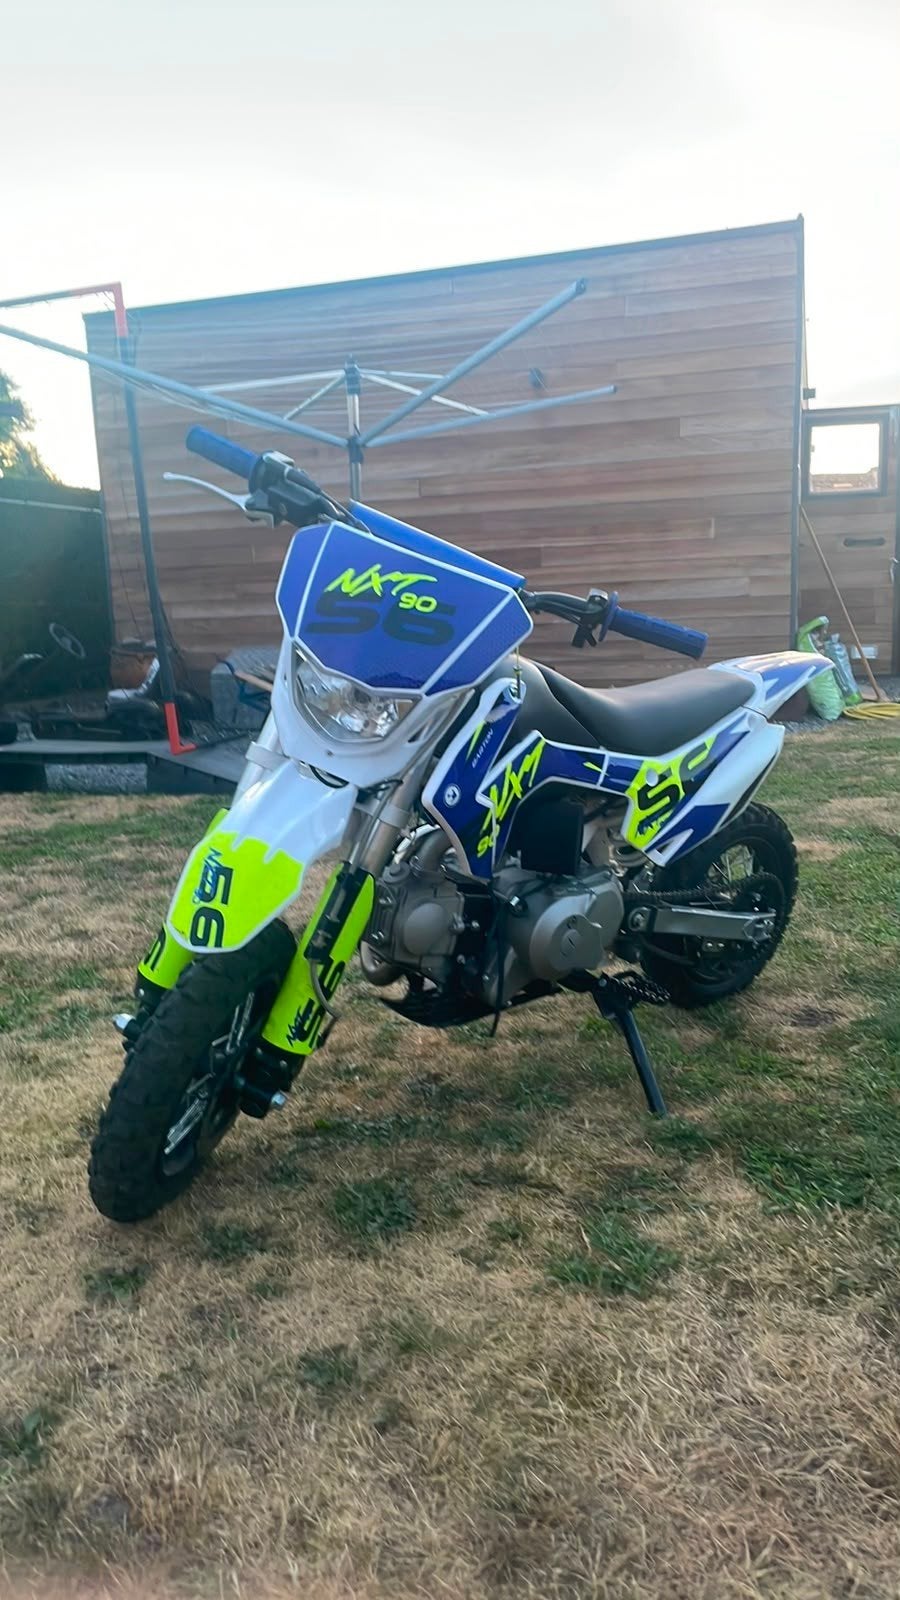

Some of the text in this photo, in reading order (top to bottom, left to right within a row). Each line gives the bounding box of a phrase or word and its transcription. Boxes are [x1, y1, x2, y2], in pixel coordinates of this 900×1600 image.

[324, 563, 437, 597] NXT
[399, 592, 437, 613] 90
[304, 590, 456, 646] 56
[190, 867, 234, 949] 56
